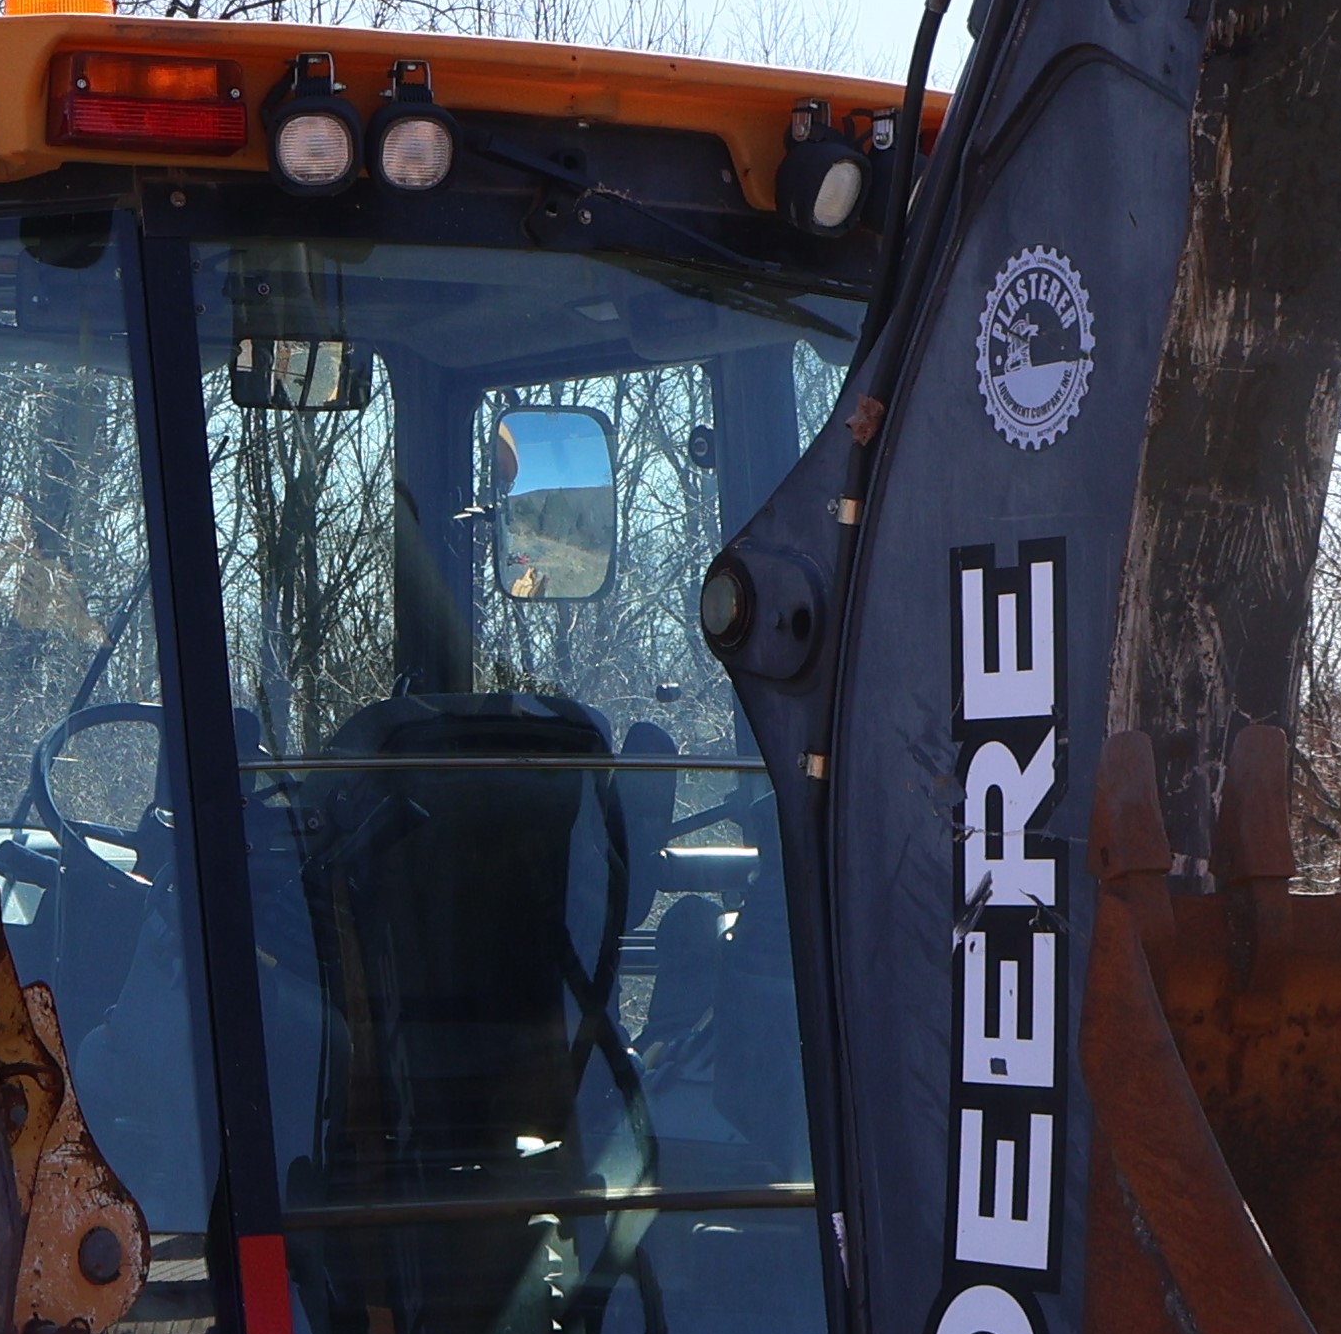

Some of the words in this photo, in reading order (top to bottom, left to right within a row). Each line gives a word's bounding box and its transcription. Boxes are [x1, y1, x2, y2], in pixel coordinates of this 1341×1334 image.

[991, 272, 1078, 343] PLASTERER
[997, 380, 1031, 419] EQUIPMENT
[1060, 367, 1074, 390] INC.
